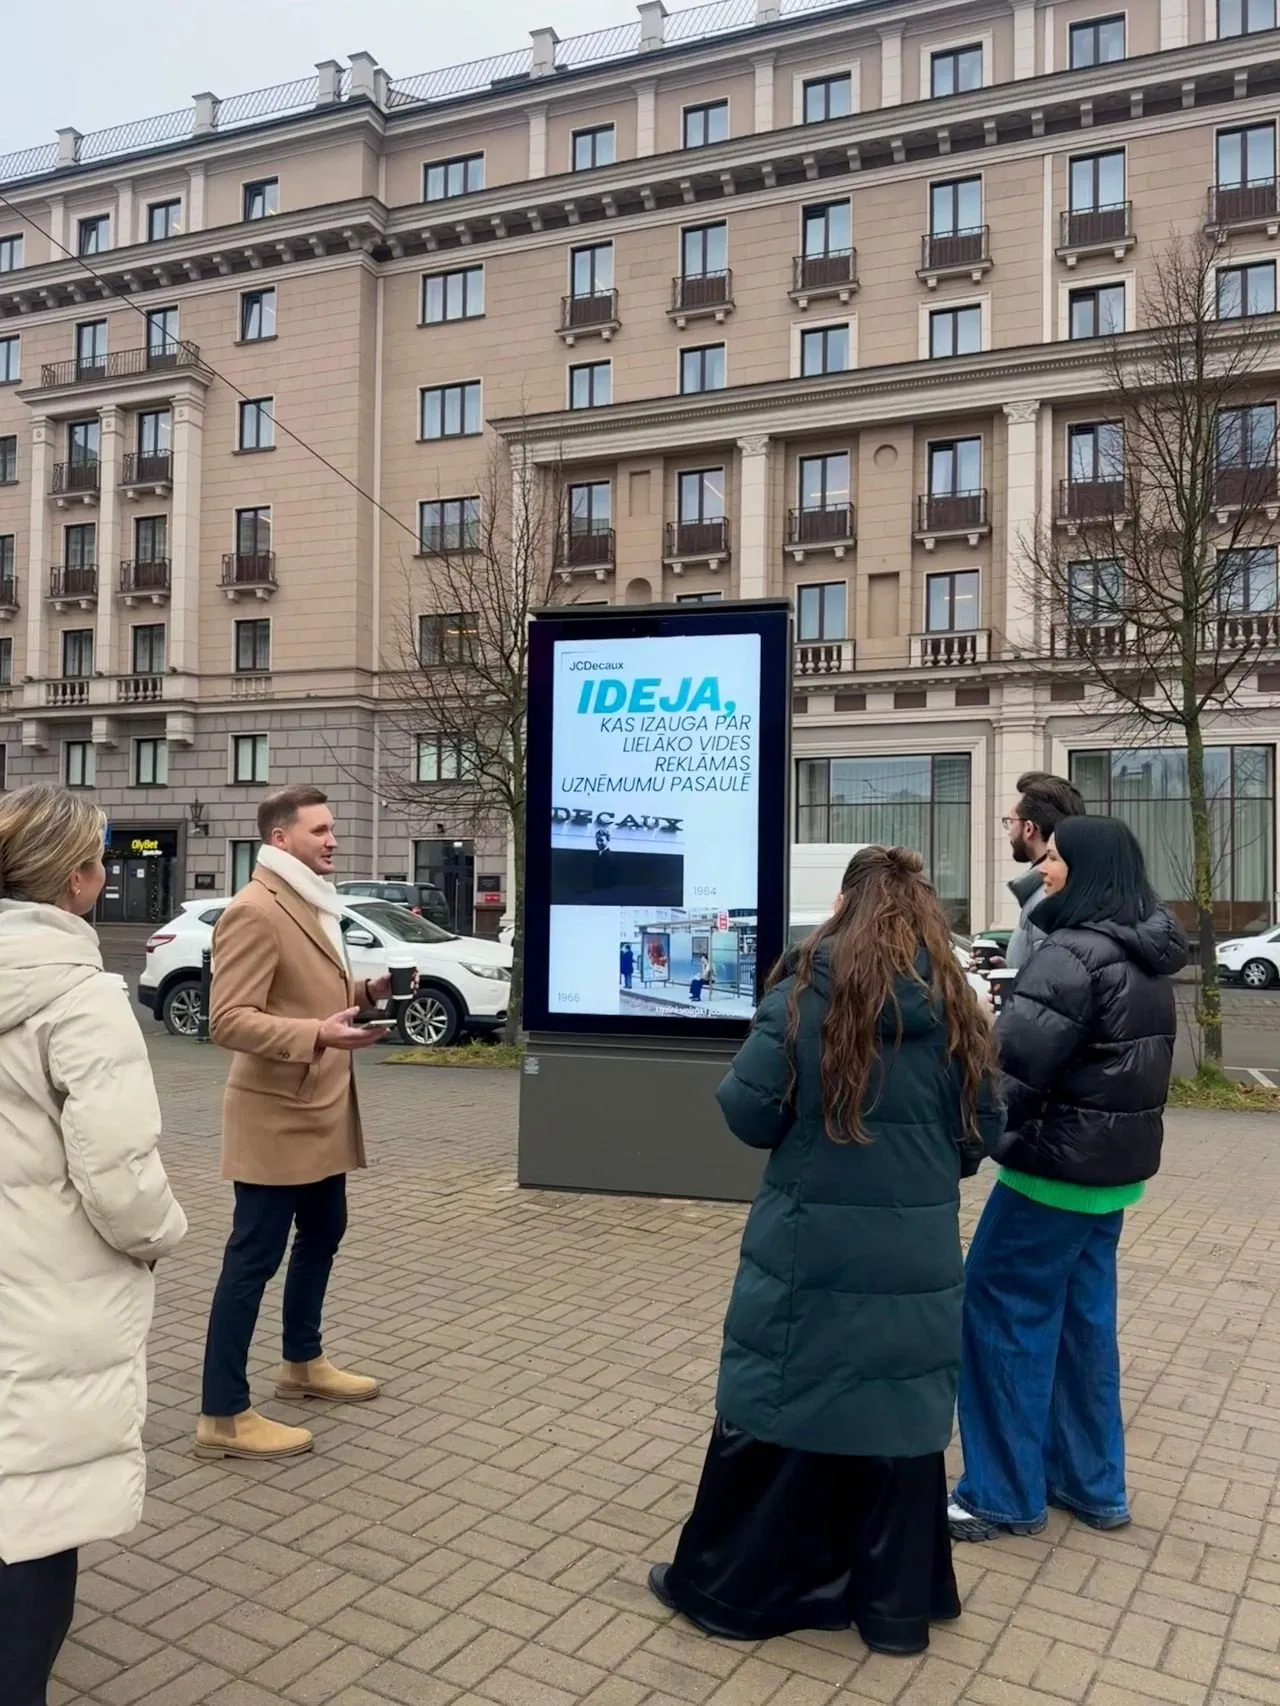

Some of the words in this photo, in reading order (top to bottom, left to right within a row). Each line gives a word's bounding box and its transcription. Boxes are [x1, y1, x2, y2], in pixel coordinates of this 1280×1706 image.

[569, 661, 624, 671] JCDecaux
[577, 676, 737, 718] IDEJA,
[600, 717, 635, 733] KAS
[640, 716, 708, 732] IZAUGA
[715, 715, 751, 731] PAR
[623, 733, 694, 752] LIELĀKO
[700, 735, 751, 751] VIDES
[655, 753, 751, 772] REKLĀMAS
[561, 774, 665, 796] UZŅĒMUMU
[670, 772, 752, 792] PASAULĒ
[552, 807, 684, 832] DECAUX
[131, 840, 159, 851] OlyBet
